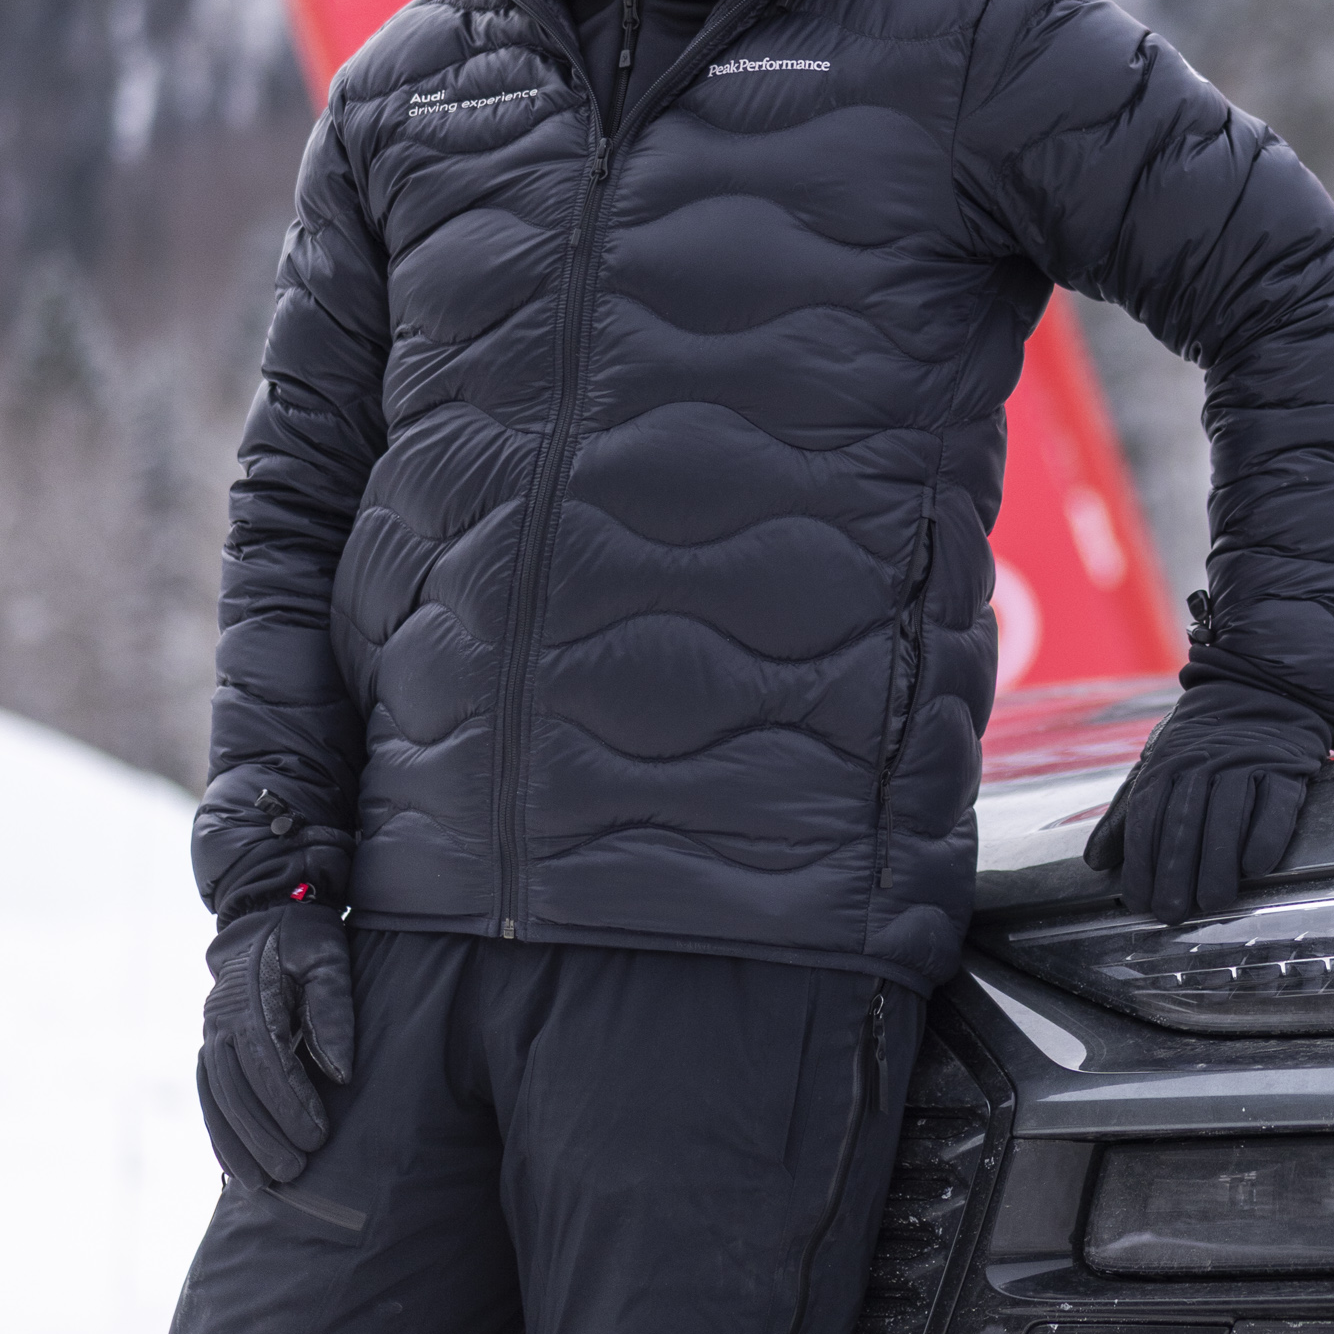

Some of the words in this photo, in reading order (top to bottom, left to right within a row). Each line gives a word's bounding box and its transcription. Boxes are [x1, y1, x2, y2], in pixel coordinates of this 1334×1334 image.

[708, 57, 830, 77] PeakPerformance
[409, 102, 457, 117] driving
[461, 88, 538, 108] experience
[410, 90, 445, 104] Audi
